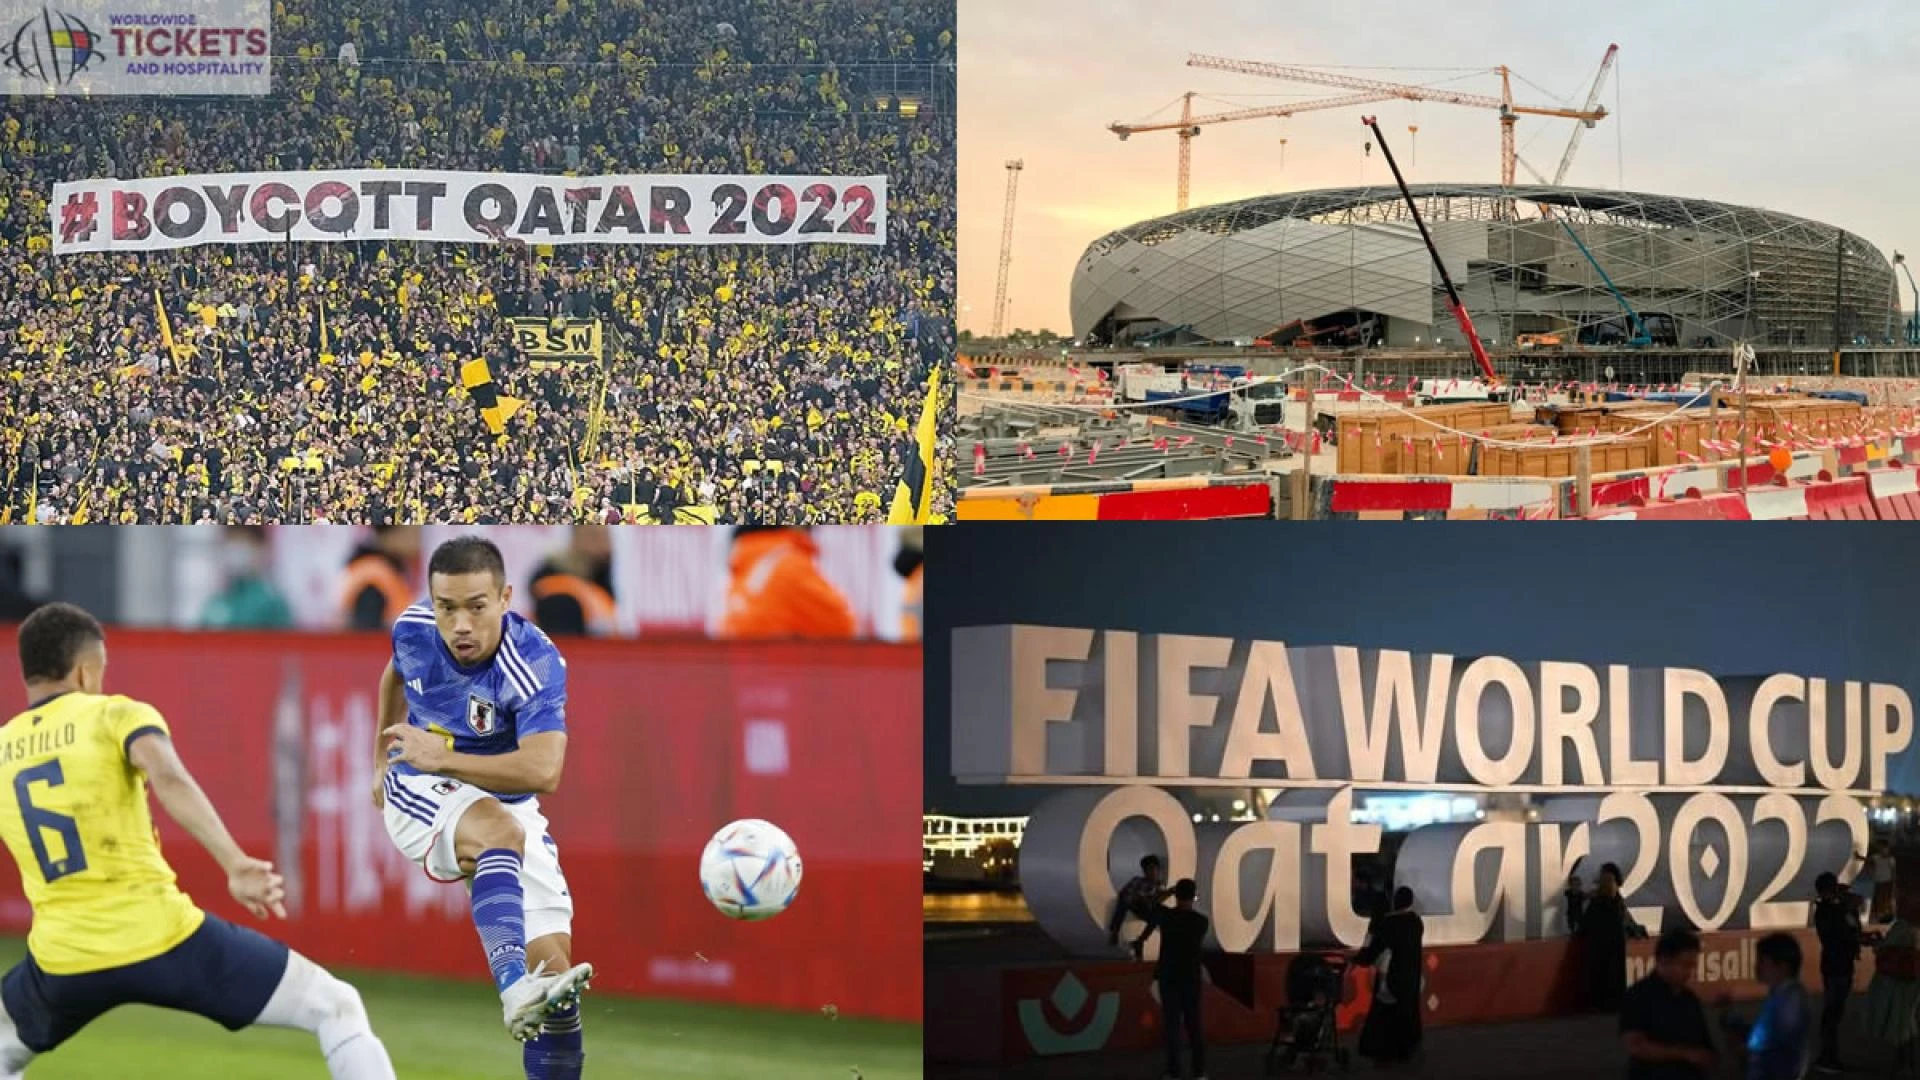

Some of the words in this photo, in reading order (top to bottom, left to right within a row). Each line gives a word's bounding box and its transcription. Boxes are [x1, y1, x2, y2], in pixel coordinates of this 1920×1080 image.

[111, 179, 448, 241] BOYCOTT
[462, 183, 693, 243] QATAR
[708, 182, 878, 237] 2022
[0, 722, 75, 767] ASTILLO
[1010, 623, 1318, 780] FIFA
[1331, 644, 1731, 787] WORLD
[1748, 671, 1914, 791] CUP
[13, 757, 88, 884] 6
